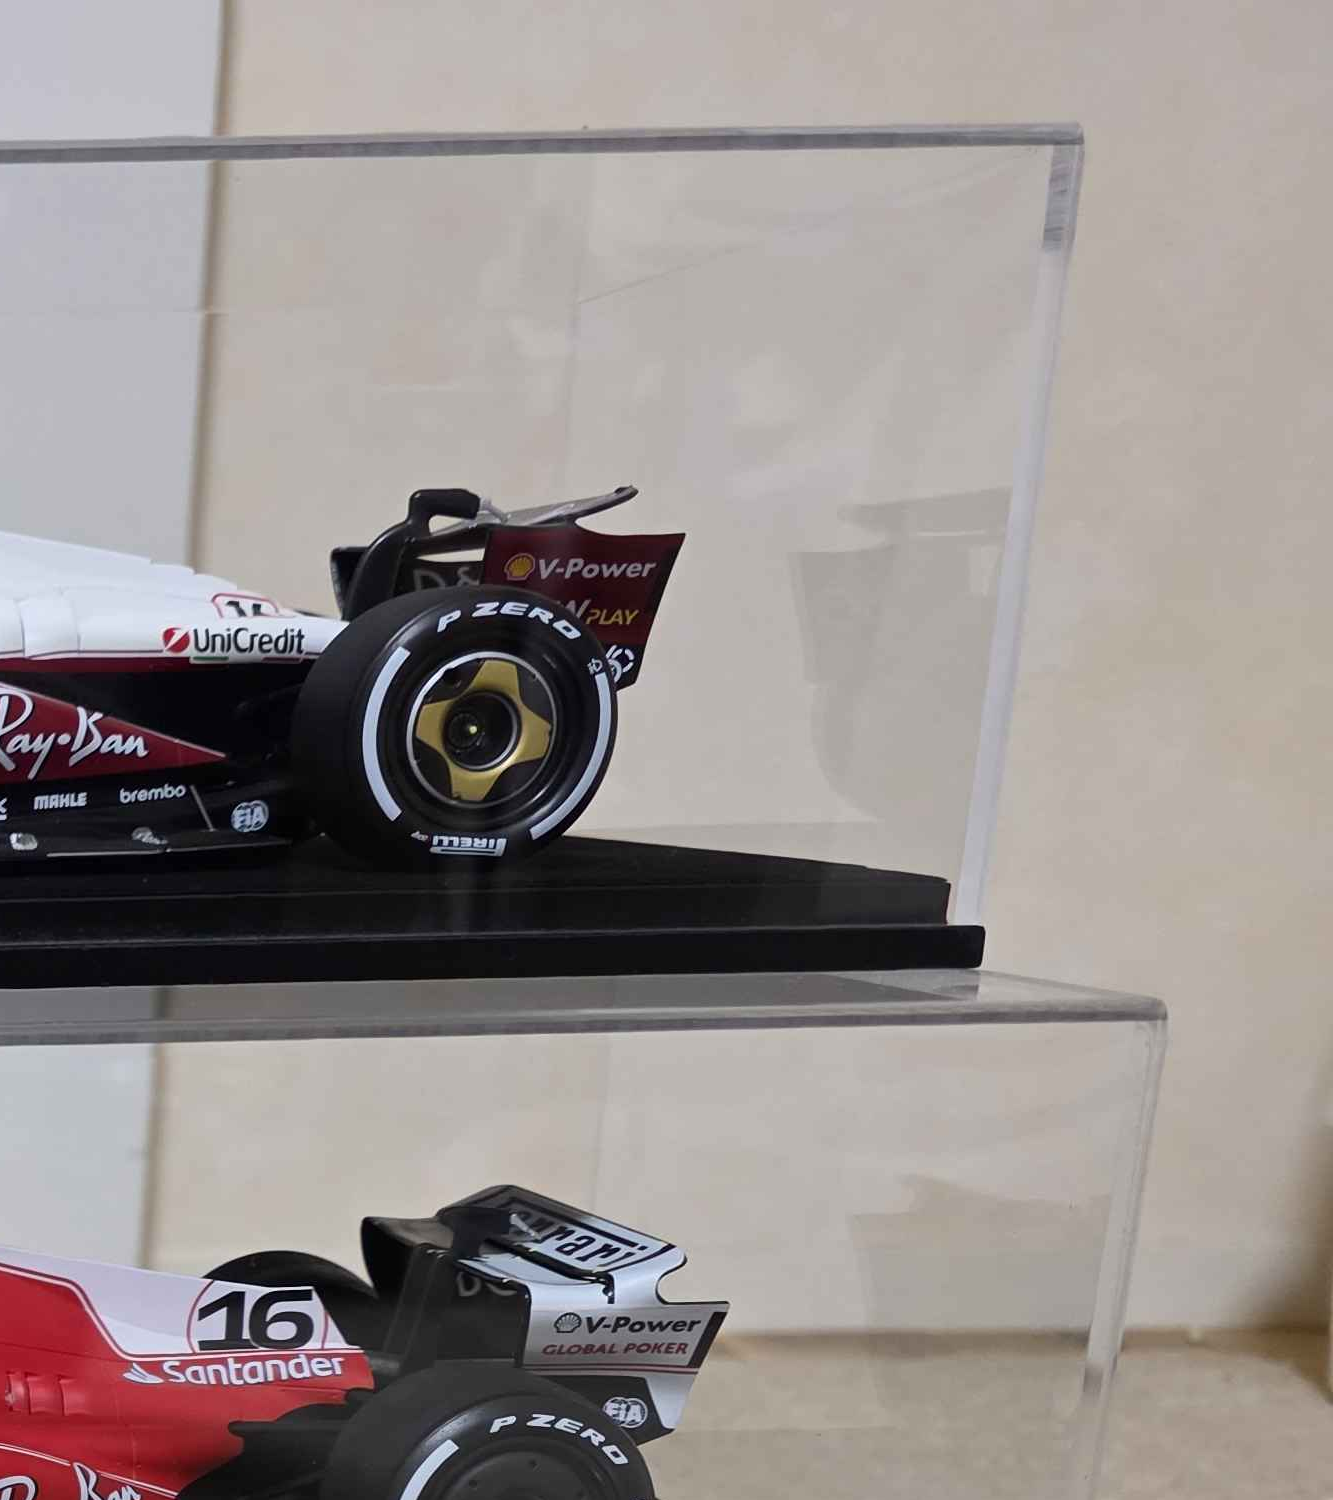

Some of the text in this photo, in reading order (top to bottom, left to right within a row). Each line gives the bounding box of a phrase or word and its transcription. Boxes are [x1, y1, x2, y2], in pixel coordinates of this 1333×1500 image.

[538, 557, 658, 581] V-Power
[471, 601, 582, 641] ZERO
[194, 627, 305, 655] UniCredit
[34, 791, 88, 810] MAHLE
[119, 784, 187, 805] brembo
[196, 1288, 315, 1351] 16
[585, 1314, 702, 1336] V-Power
[541, 1341, 690, 1357] GLOBAL POKER
[162, 1353, 345, 1387] Santander
[526, 1413, 630, 1466] ZERO
